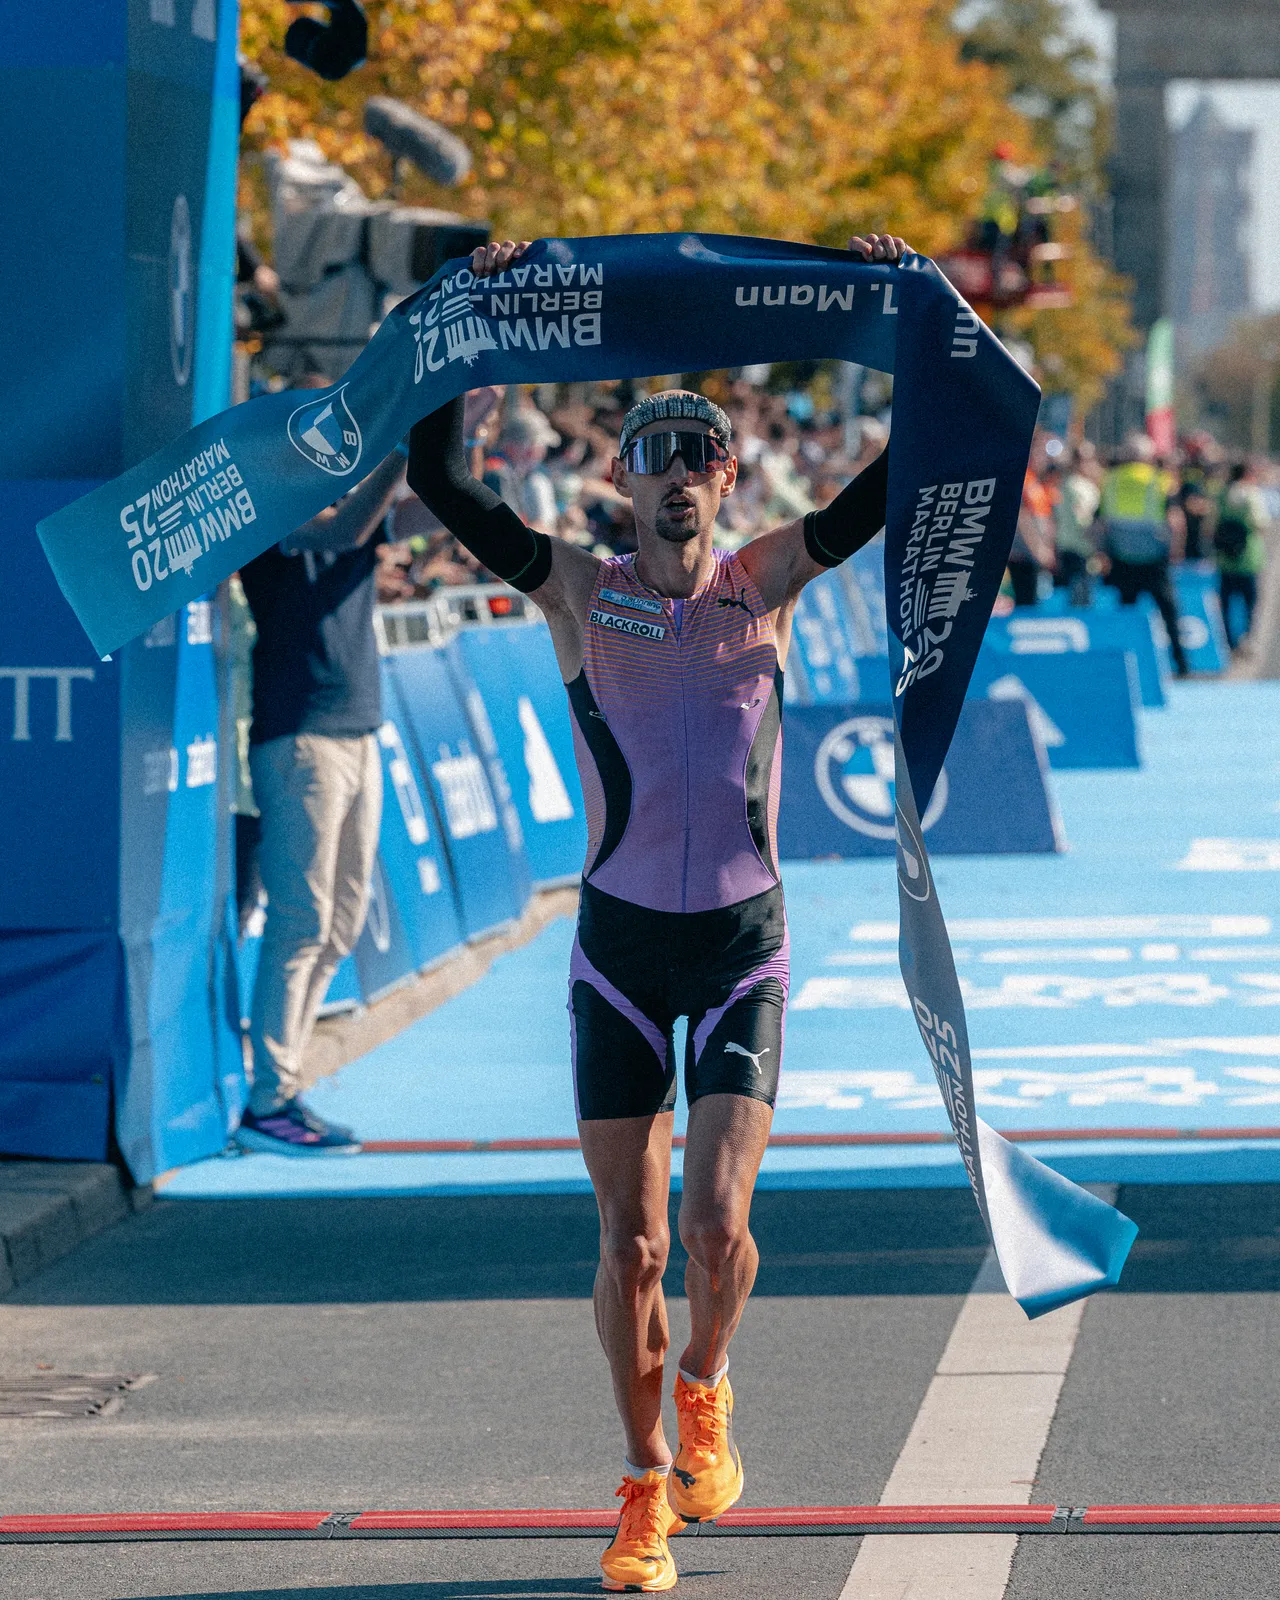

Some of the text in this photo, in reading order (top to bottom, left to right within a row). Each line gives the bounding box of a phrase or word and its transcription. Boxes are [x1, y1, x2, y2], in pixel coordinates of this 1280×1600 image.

[491, 290, 603, 317] BERLIN
[735, 283, 899, 315] 1. Mann
[498, 312, 602, 352] BMW
[151, 437, 232, 511] MARATHON
[186, 463, 244, 517] BERLIN
[119, 492, 157, 550] 25
[199, 487, 258, 553] BMW
[919, 482, 964, 573] BERLIN
[943, 477, 997, 568] BMW
[131, 536, 169, 592] 20
[899, 484, 938, 642] MARATHON
[589, 611, 663, 640] BLACKROLL
[916, 621, 954, 680] 20
[933, 1012, 962, 1080] 25
